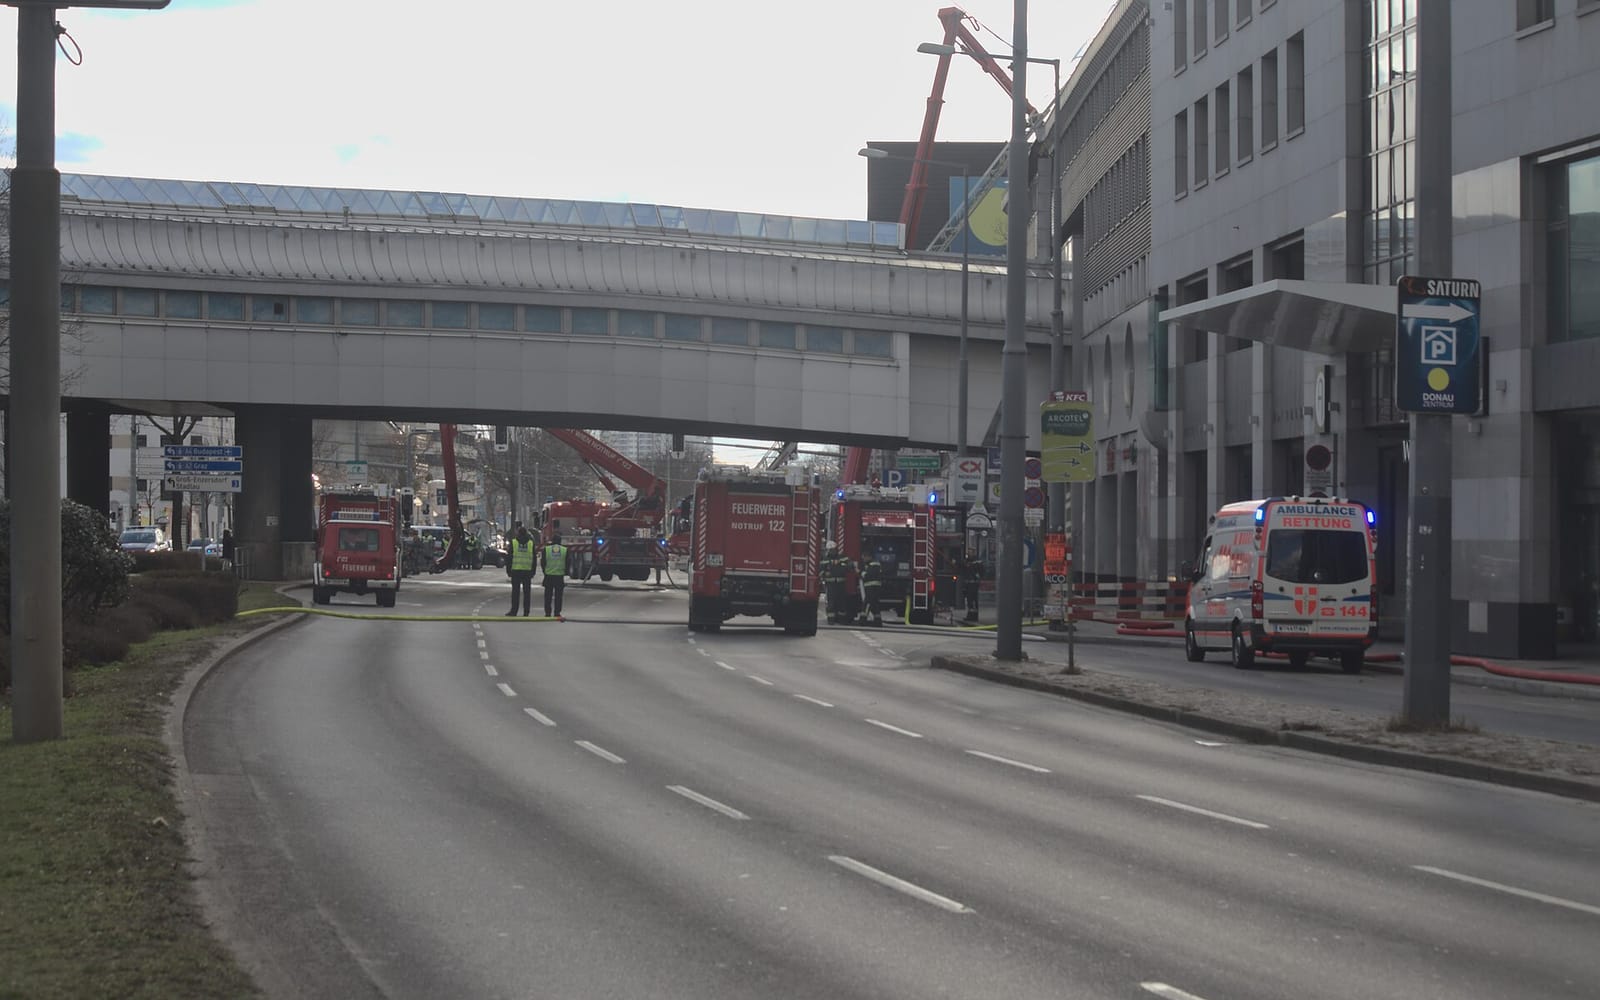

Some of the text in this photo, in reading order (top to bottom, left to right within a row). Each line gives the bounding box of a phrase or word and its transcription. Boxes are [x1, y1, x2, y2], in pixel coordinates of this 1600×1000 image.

[1427, 280, 1480, 298] SATURN
[1431, 340, 1446, 359] P
[1065, 394, 1087, 402] KFC
[1423, 393, 1454, 402] DONAU
[1048, 414, 1083, 423] ARCOTEL
[193, 448, 223, 456] Budapest
[888, 470, 902, 487] P
[731, 503, 786, 516] FEUERWEHR
[1277, 505, 1357, 516] AMBULANCE
[731, 520, 785, 532] NOTRUF 122
[1283, 517, 1352, 529] RETTUNG
[342, 564, 376, 572] FEUERWEHR
[1340, 605, 1368, 617] 144
